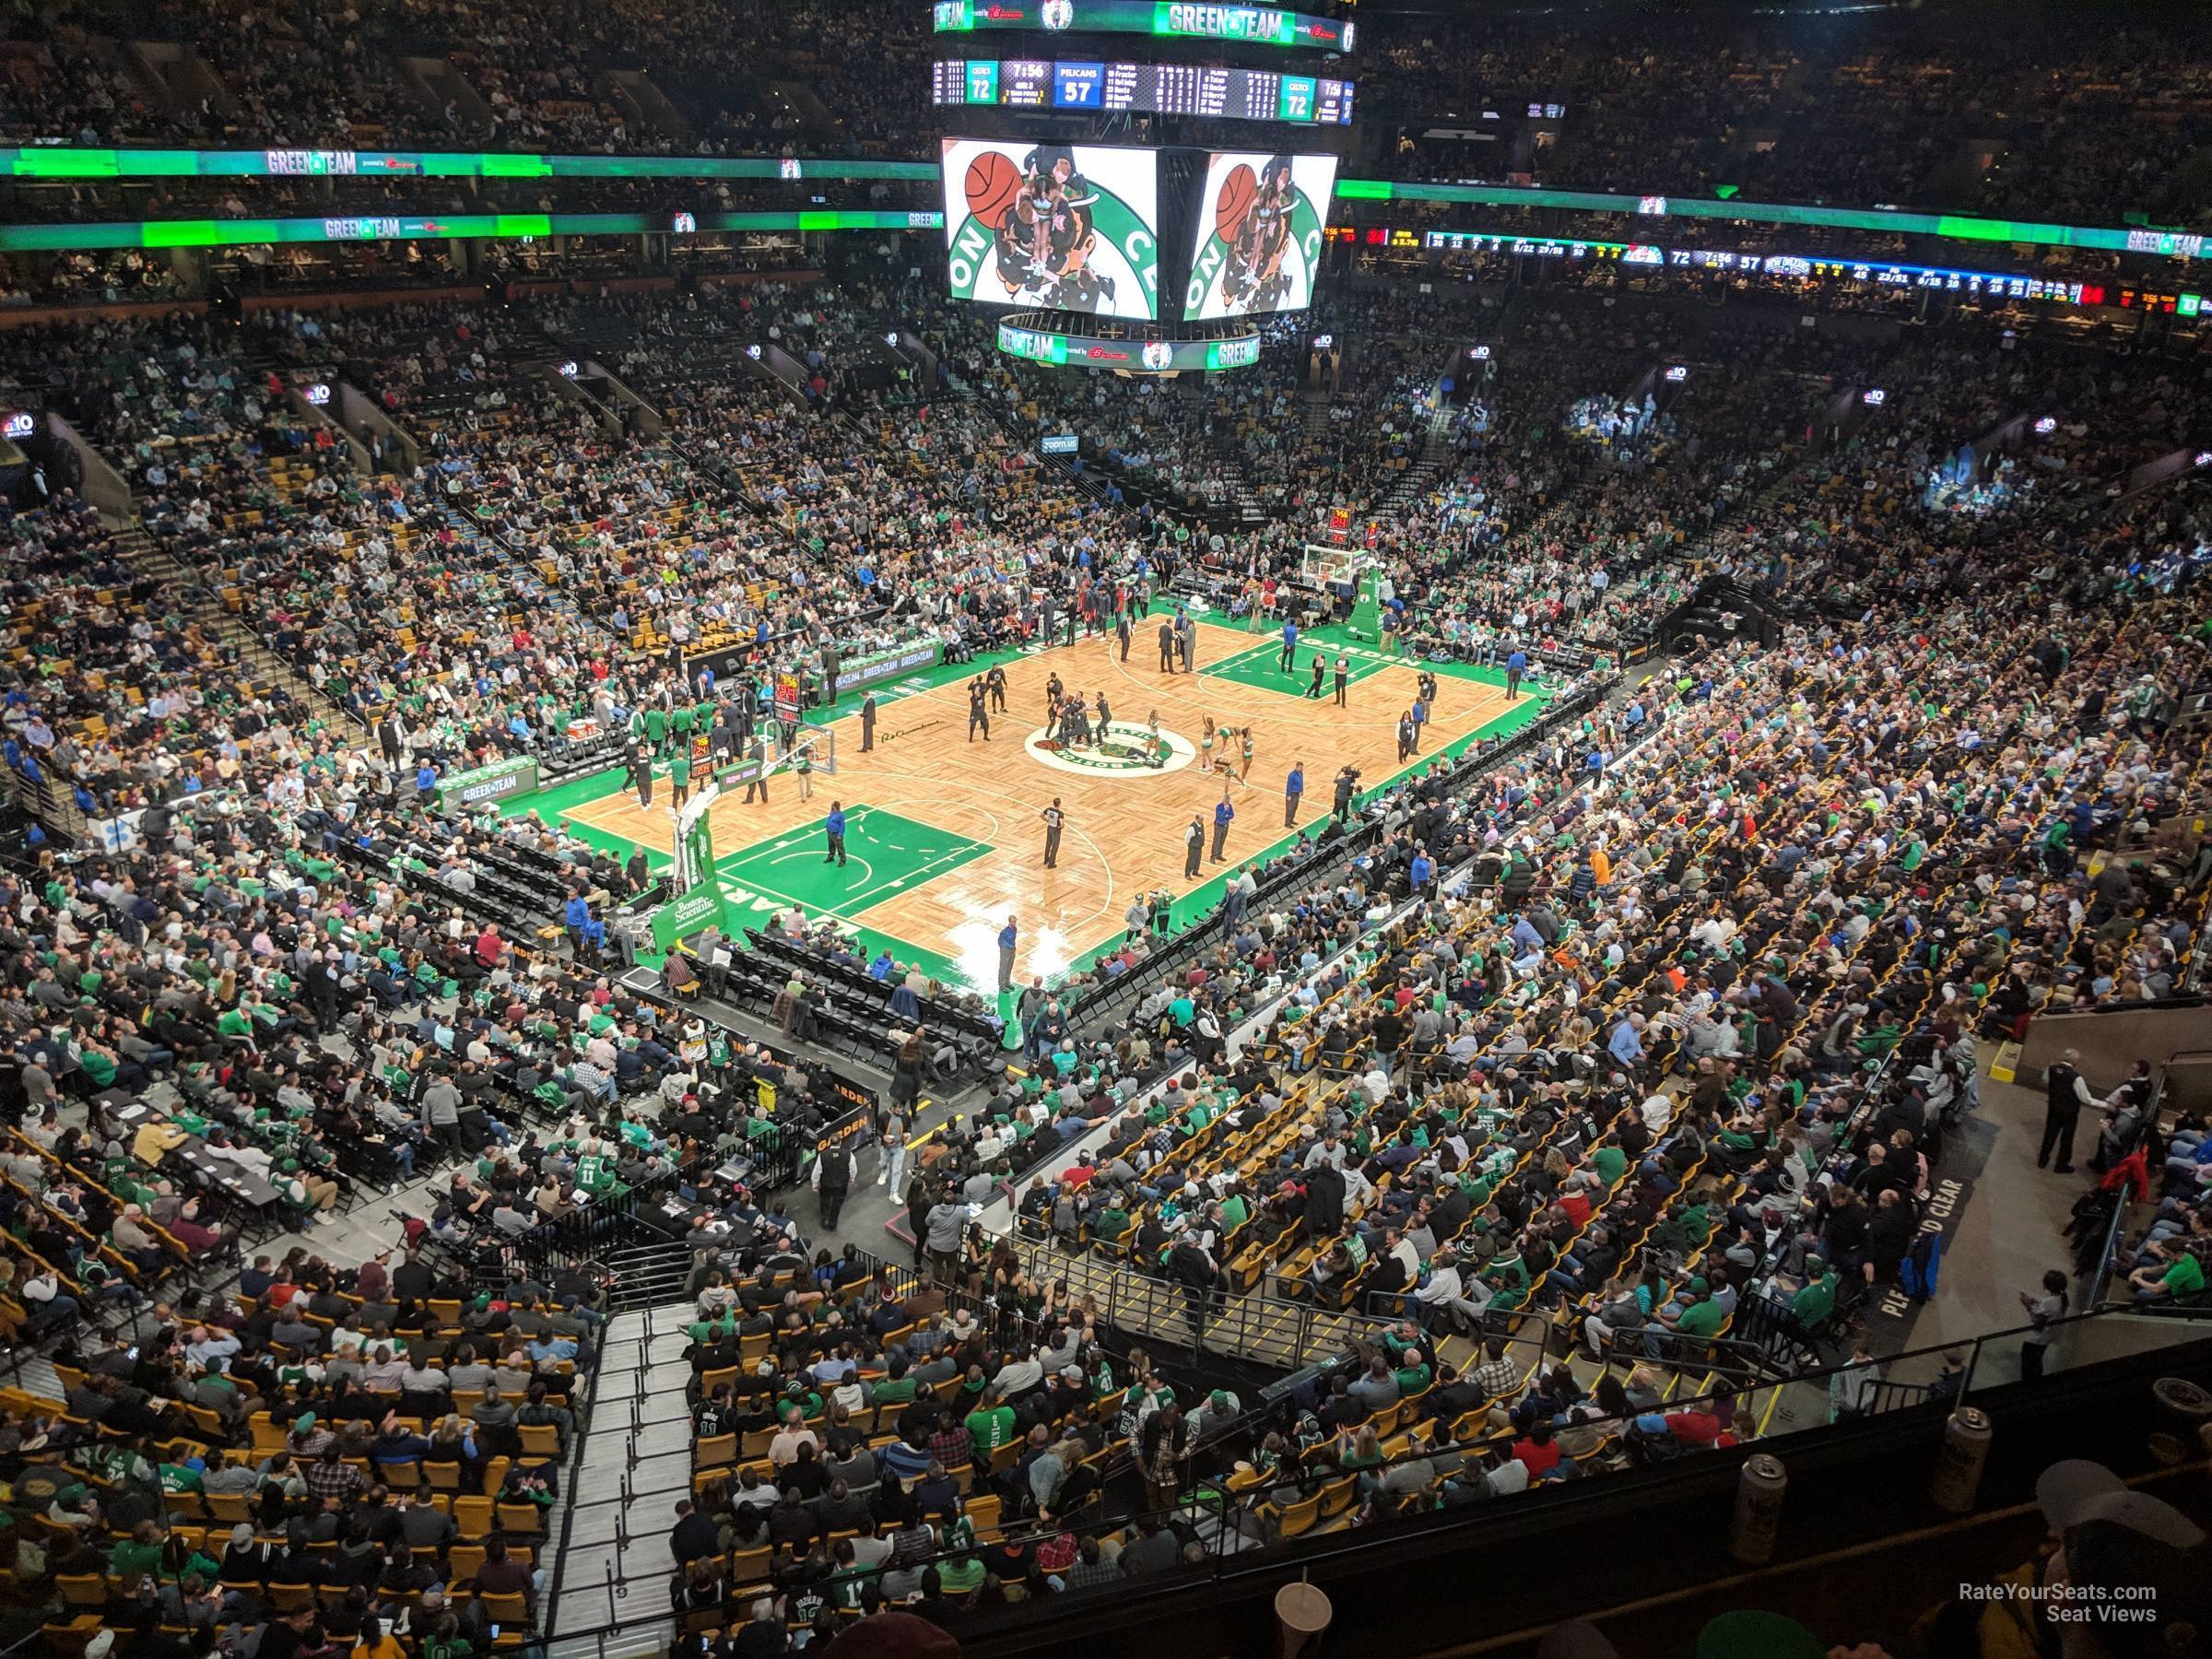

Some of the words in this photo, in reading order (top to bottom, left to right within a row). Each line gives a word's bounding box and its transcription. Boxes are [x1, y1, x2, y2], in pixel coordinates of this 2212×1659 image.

[1170, 5, 1227, 35] GREEN
[1238, 10, 1282, 40] TEAM
[1014, 65, 1043, 77] 7:56
[1061, 68, 1098, 77] PELICANS
[972, 79, 990, 99] 72
[1065, 82, 1091, 101] 57
[1288, 96, 1307, 115] 72
[267, 151, 311, 173] GREEN
[322, 152, 356, 173] TEAM
[909, 213, 935, 227] GREEN
[325, 220, 362, 238] GREEN
[370, 219, 400, 237] TEAM
[1452, 241, 1463, 249] 12
[1572, 249, 1584, 257] 50
[2127, 230, 2166, 253] GREEN
[2171, 234, 2203, 257] TEAM
[1673, 252, 1688, 264] 72
[1705, 252, 1732, 263] 7:56
[1740, 256, 1759, 269] 57
[1766, 257, 1783, 270] NEW
[1853, 271, 1866, 279] 45
[1877, 273, 1908, 283] 23/51
[1918, 276, 1941, 287] 6/15
[1947, 279, 1959, 288] 10
[1989, 284, 2002, 292] 19
[2009, 287, 2023, 295] 23
[2183, 299, 2197, 310] TD
[1024, 334, 1054, 359] TEAM
[1323, 335, 1332, 345] 10
[1219, 343, 1250, 364] GREEN
[1477, 346, 1489, 356] 10
[1675, 367, 1686, 377] 10
[313, 385, 330, 399] 10
[1872, 390, 1884, 401] 10
[14, 415, 34, 430] 10
[1042, 440, 1077, 449] zoom.us
[1301, 634, 1422, 667] GARDEN
[782, 674, 797, 688] 7:56
[464, 783, 490, 801] GREEN
[496, 775, 516, 793] TEAM
[675, 898, 715, 923] Scientific
[678, 896, 704, 912] Boston
[713, 1049, 721, 1058] 0
[834, 1083, 872, 1110] ARDEN
[582, 1170, 594, 1184] 11
[1928, 1178, 1964, 1218] CLEAR
[700, 1421, 716, 1435] 11
